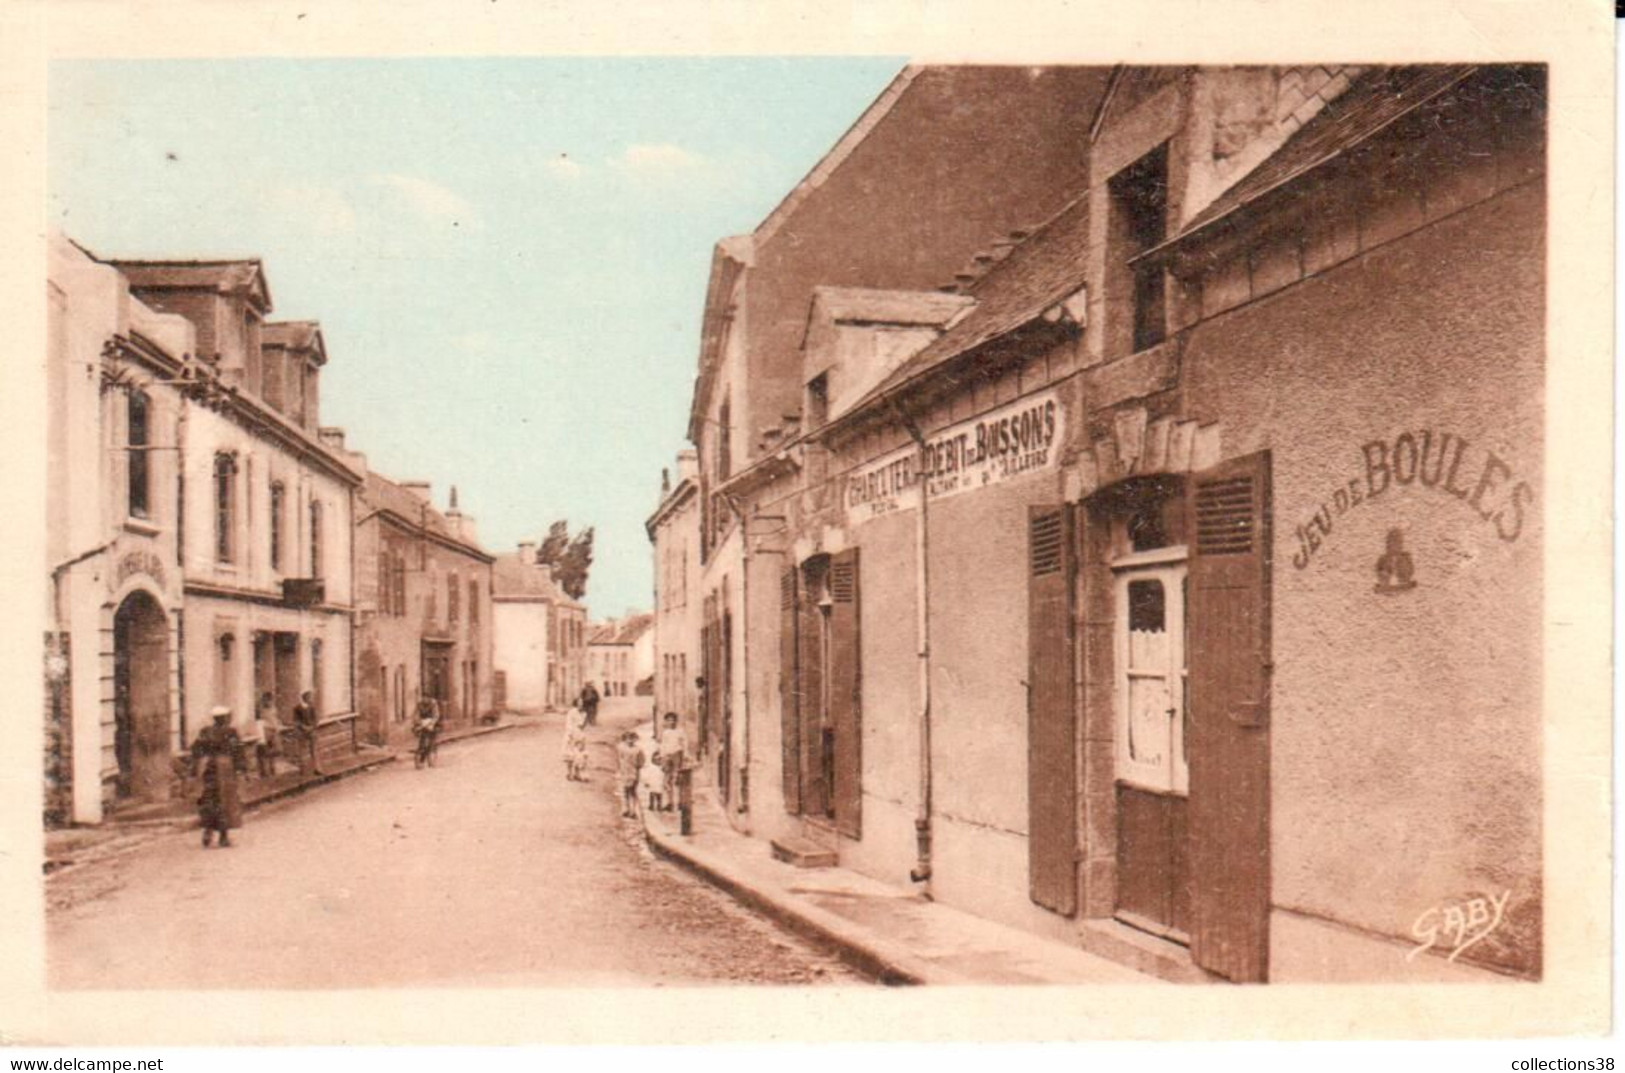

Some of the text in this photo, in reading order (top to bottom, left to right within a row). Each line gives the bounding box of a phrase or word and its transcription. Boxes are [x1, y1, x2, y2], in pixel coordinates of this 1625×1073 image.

[1293, 428, 1534, 571] JEU DE BOULES
